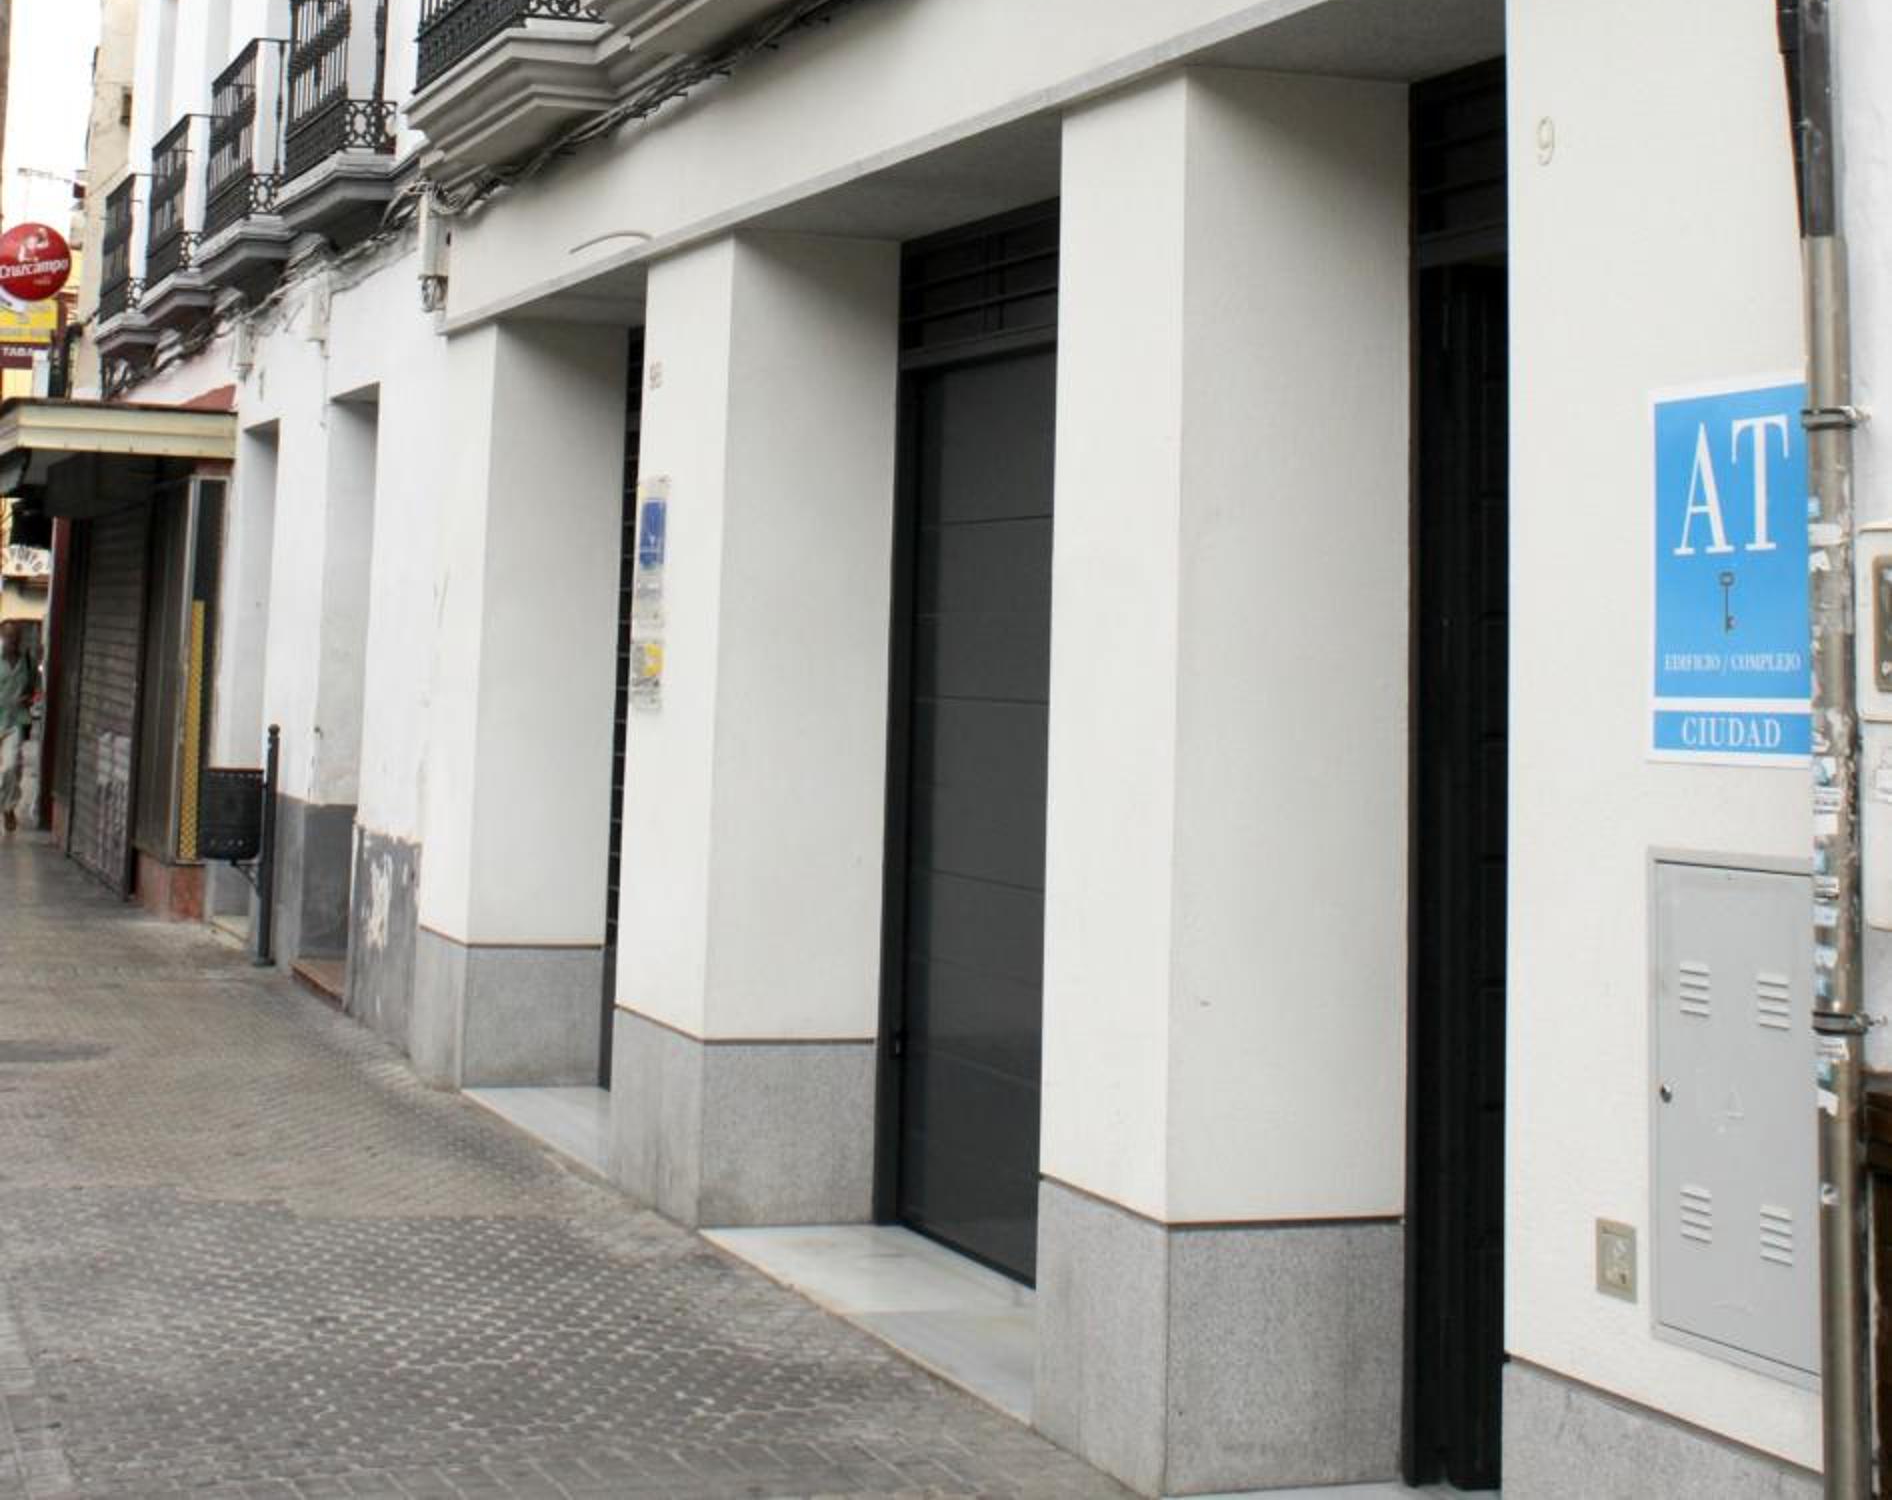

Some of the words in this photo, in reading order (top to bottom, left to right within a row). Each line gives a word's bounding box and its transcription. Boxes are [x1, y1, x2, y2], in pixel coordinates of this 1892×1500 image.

[0, 259, 69, 278] Cruzcampo
[1673, 414, 1789, 556] AT
[1663, 653, 1721, 671] EDIFICIO
[1731, 652, 1801, 671] COMPLEJO
[1682, 715, 1781, 748] CIUDAD
